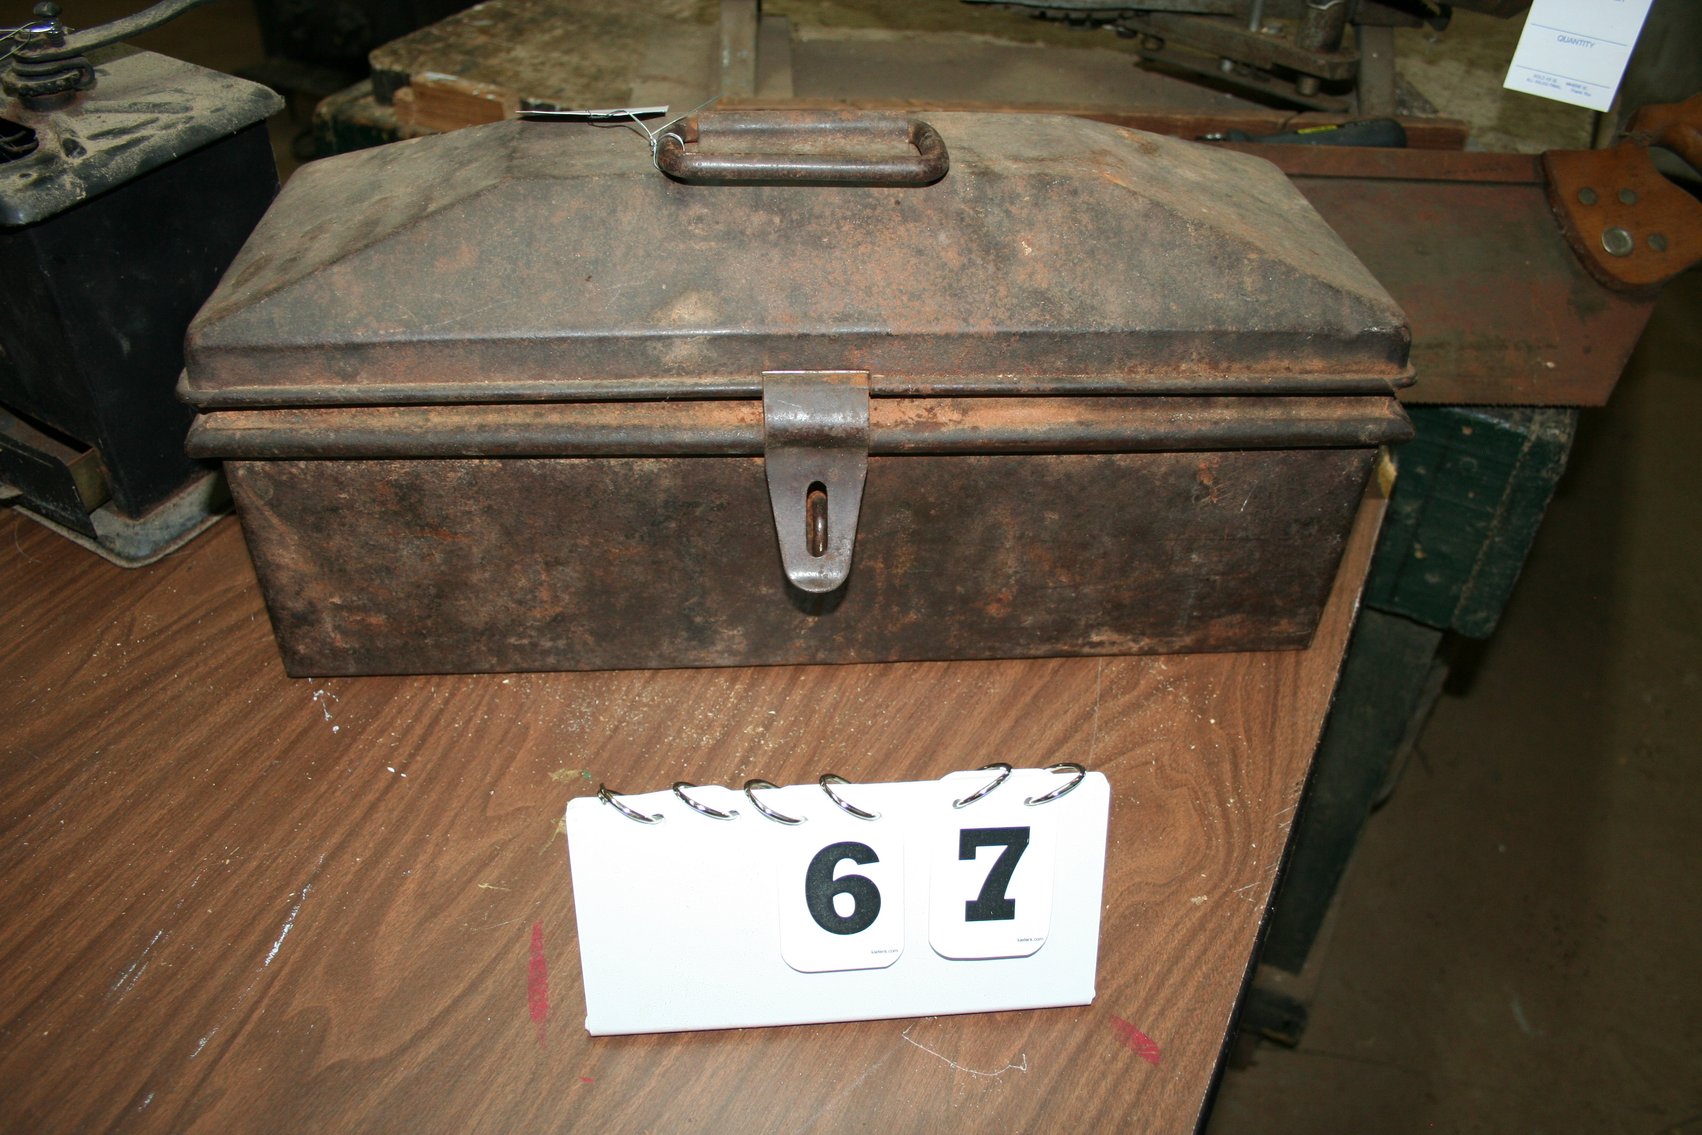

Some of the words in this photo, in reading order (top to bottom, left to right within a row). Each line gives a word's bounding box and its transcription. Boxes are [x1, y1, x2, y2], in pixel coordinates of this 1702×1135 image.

[1557, 35, 1595, 48] QUANTITY
[805, 841, 882, 935] 6
[958, 825, 1031, 921] 7
